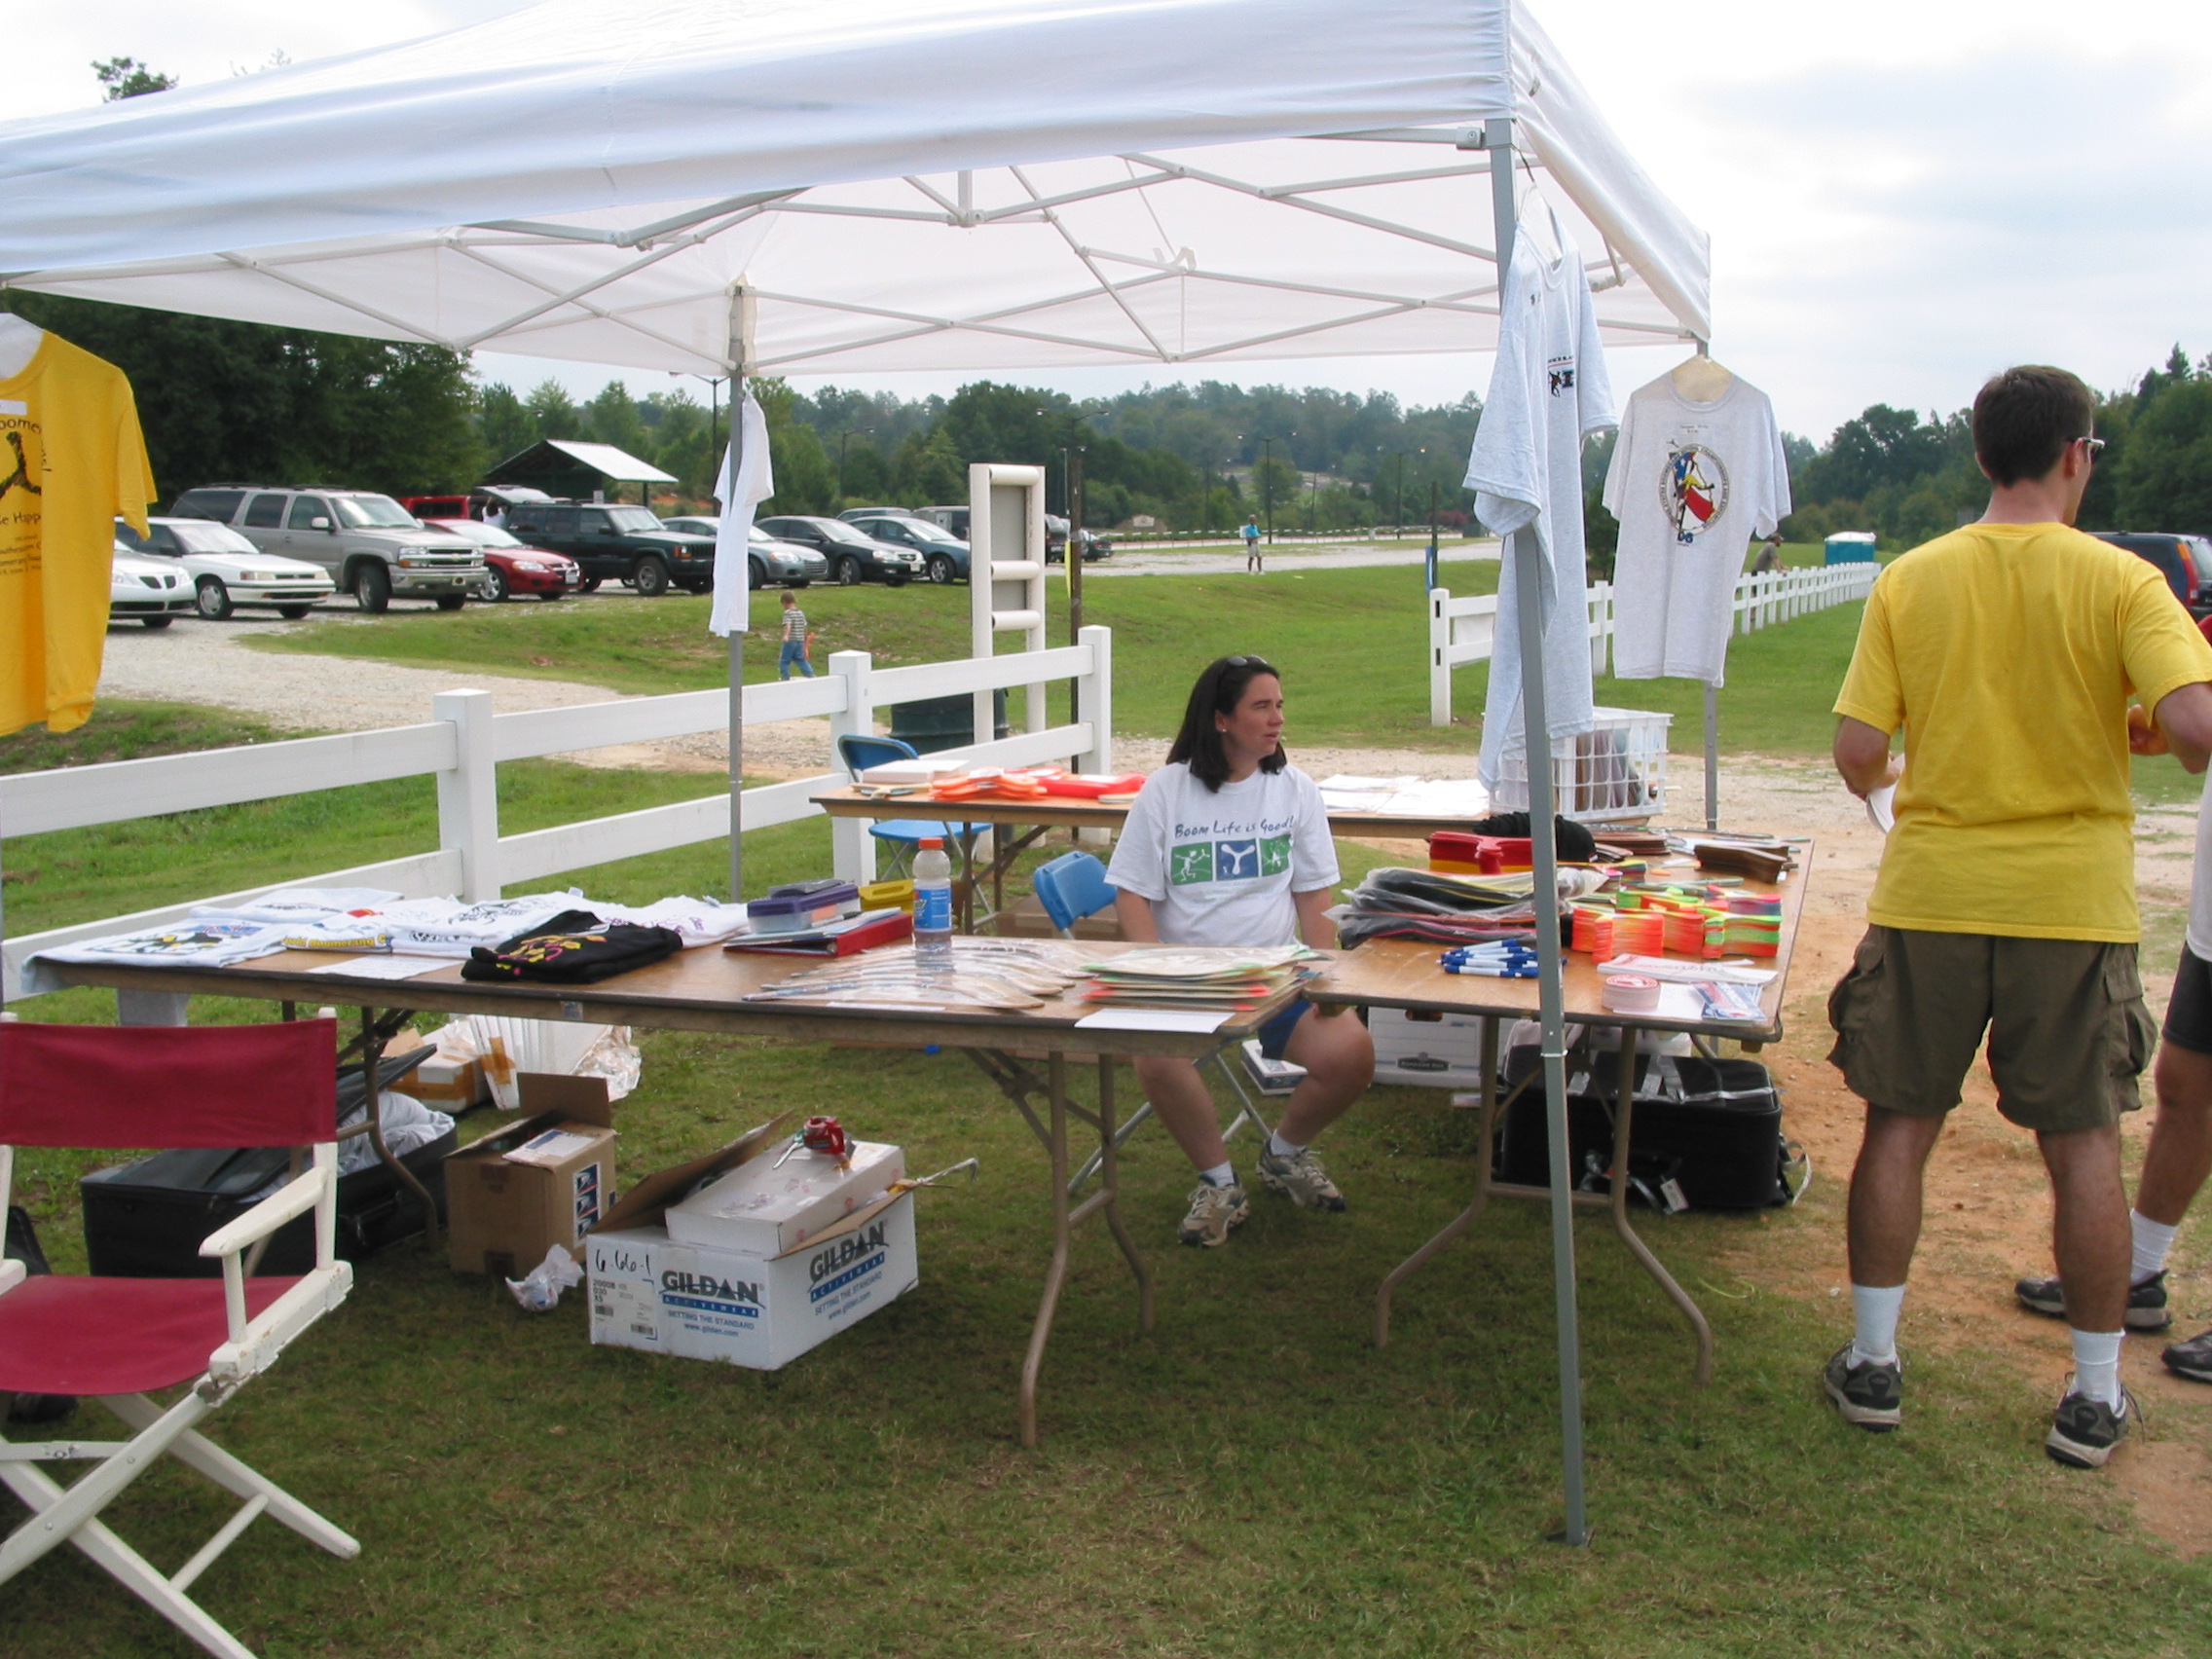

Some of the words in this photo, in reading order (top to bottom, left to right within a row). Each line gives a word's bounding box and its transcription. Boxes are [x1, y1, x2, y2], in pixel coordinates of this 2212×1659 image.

[1175, 824, 1208, 837] Boom
[1213, 820, 1240, 836] Life
[1261, 815, 1294, 833] Good!
[809, 1222, 884, 1282] GILDAN
[661, 1270, 758, 1304] GILDAN
[812, 1253, 884, 1300] ACTIVEWEAR
[664, 1296, 757, 1316] ACTIVEWEAR
[668, 1310, 698, 1321] SETTING
[699, 1314, 713, 1323] THE
[716, 1317, 755, 1330] STANDARD
